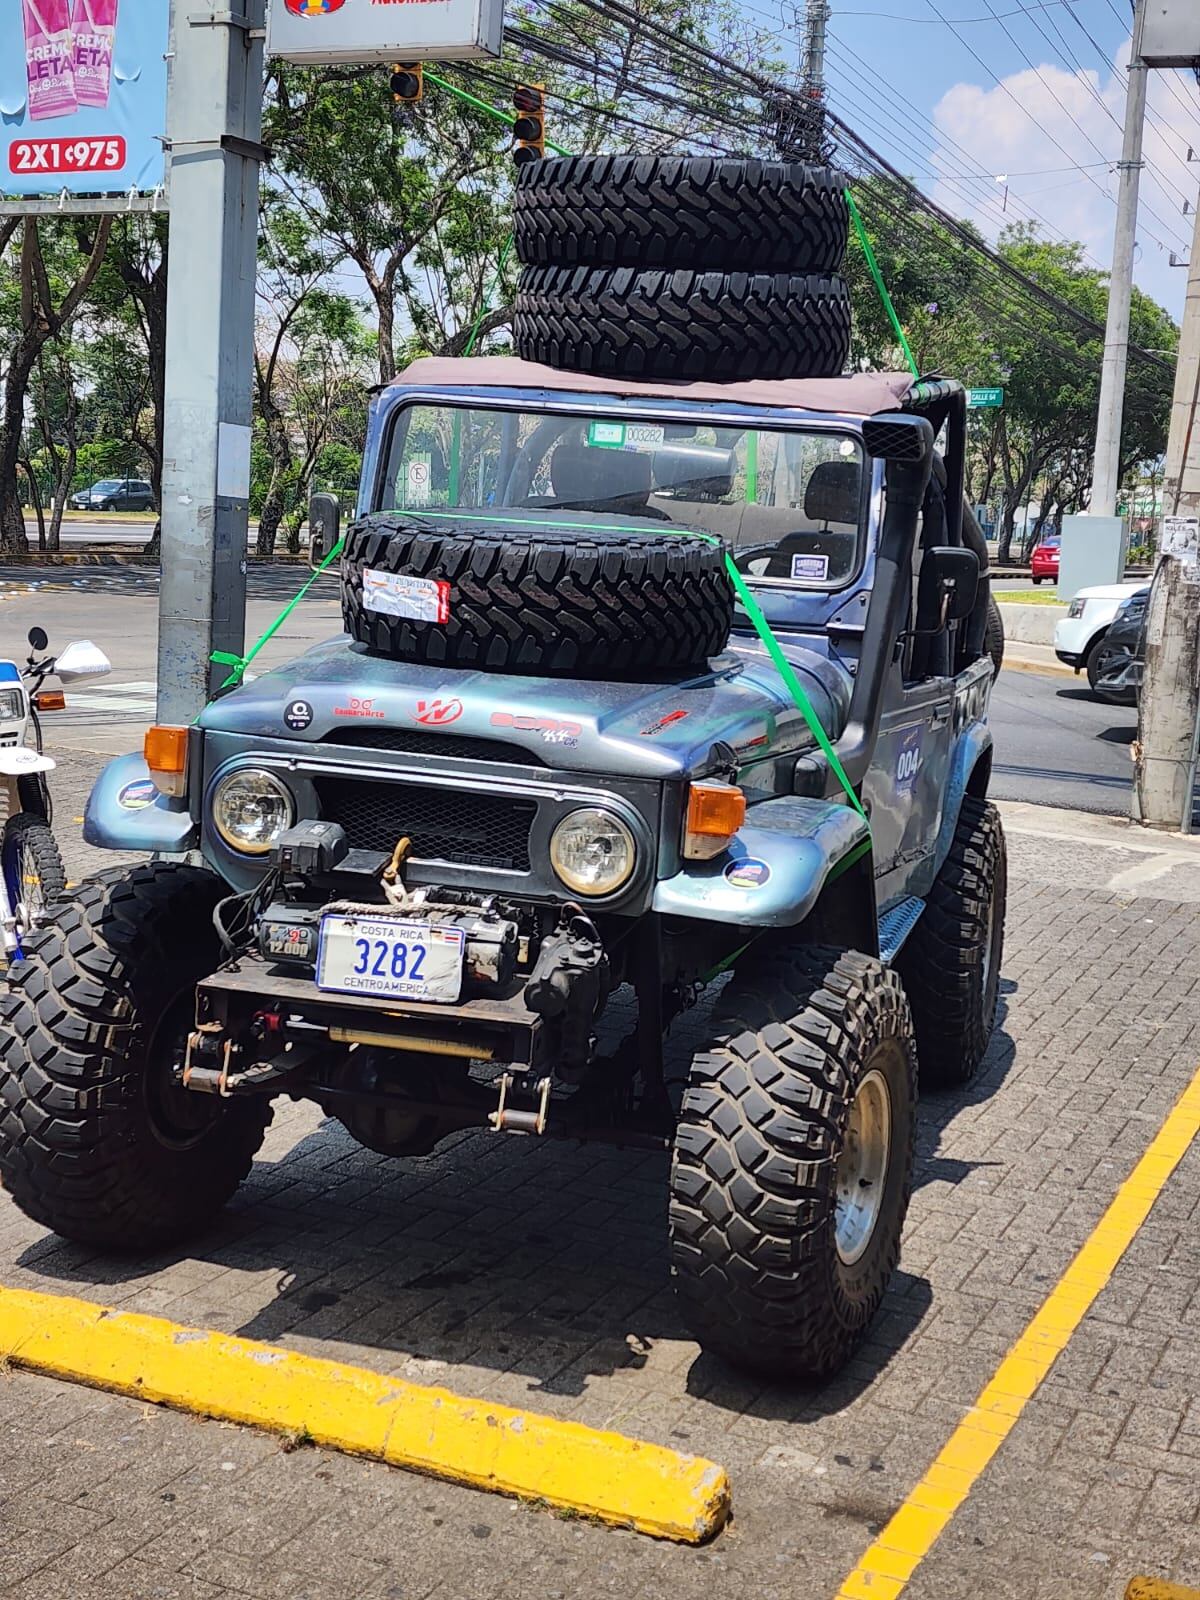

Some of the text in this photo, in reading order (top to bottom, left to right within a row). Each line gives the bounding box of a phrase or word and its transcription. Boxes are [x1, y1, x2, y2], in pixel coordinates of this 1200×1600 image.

[27, 55, 74, 81] LETA
[17, 144, 60, 168] 2X1
[627, 427, 662, 442] 003282
[897, 748, 921, 780] 004
[361, 926, 424, 941] COSTA RICA
[354, 938, 426, 981] 3282
[344, 977, 433, 995] CENTROAMERICA
